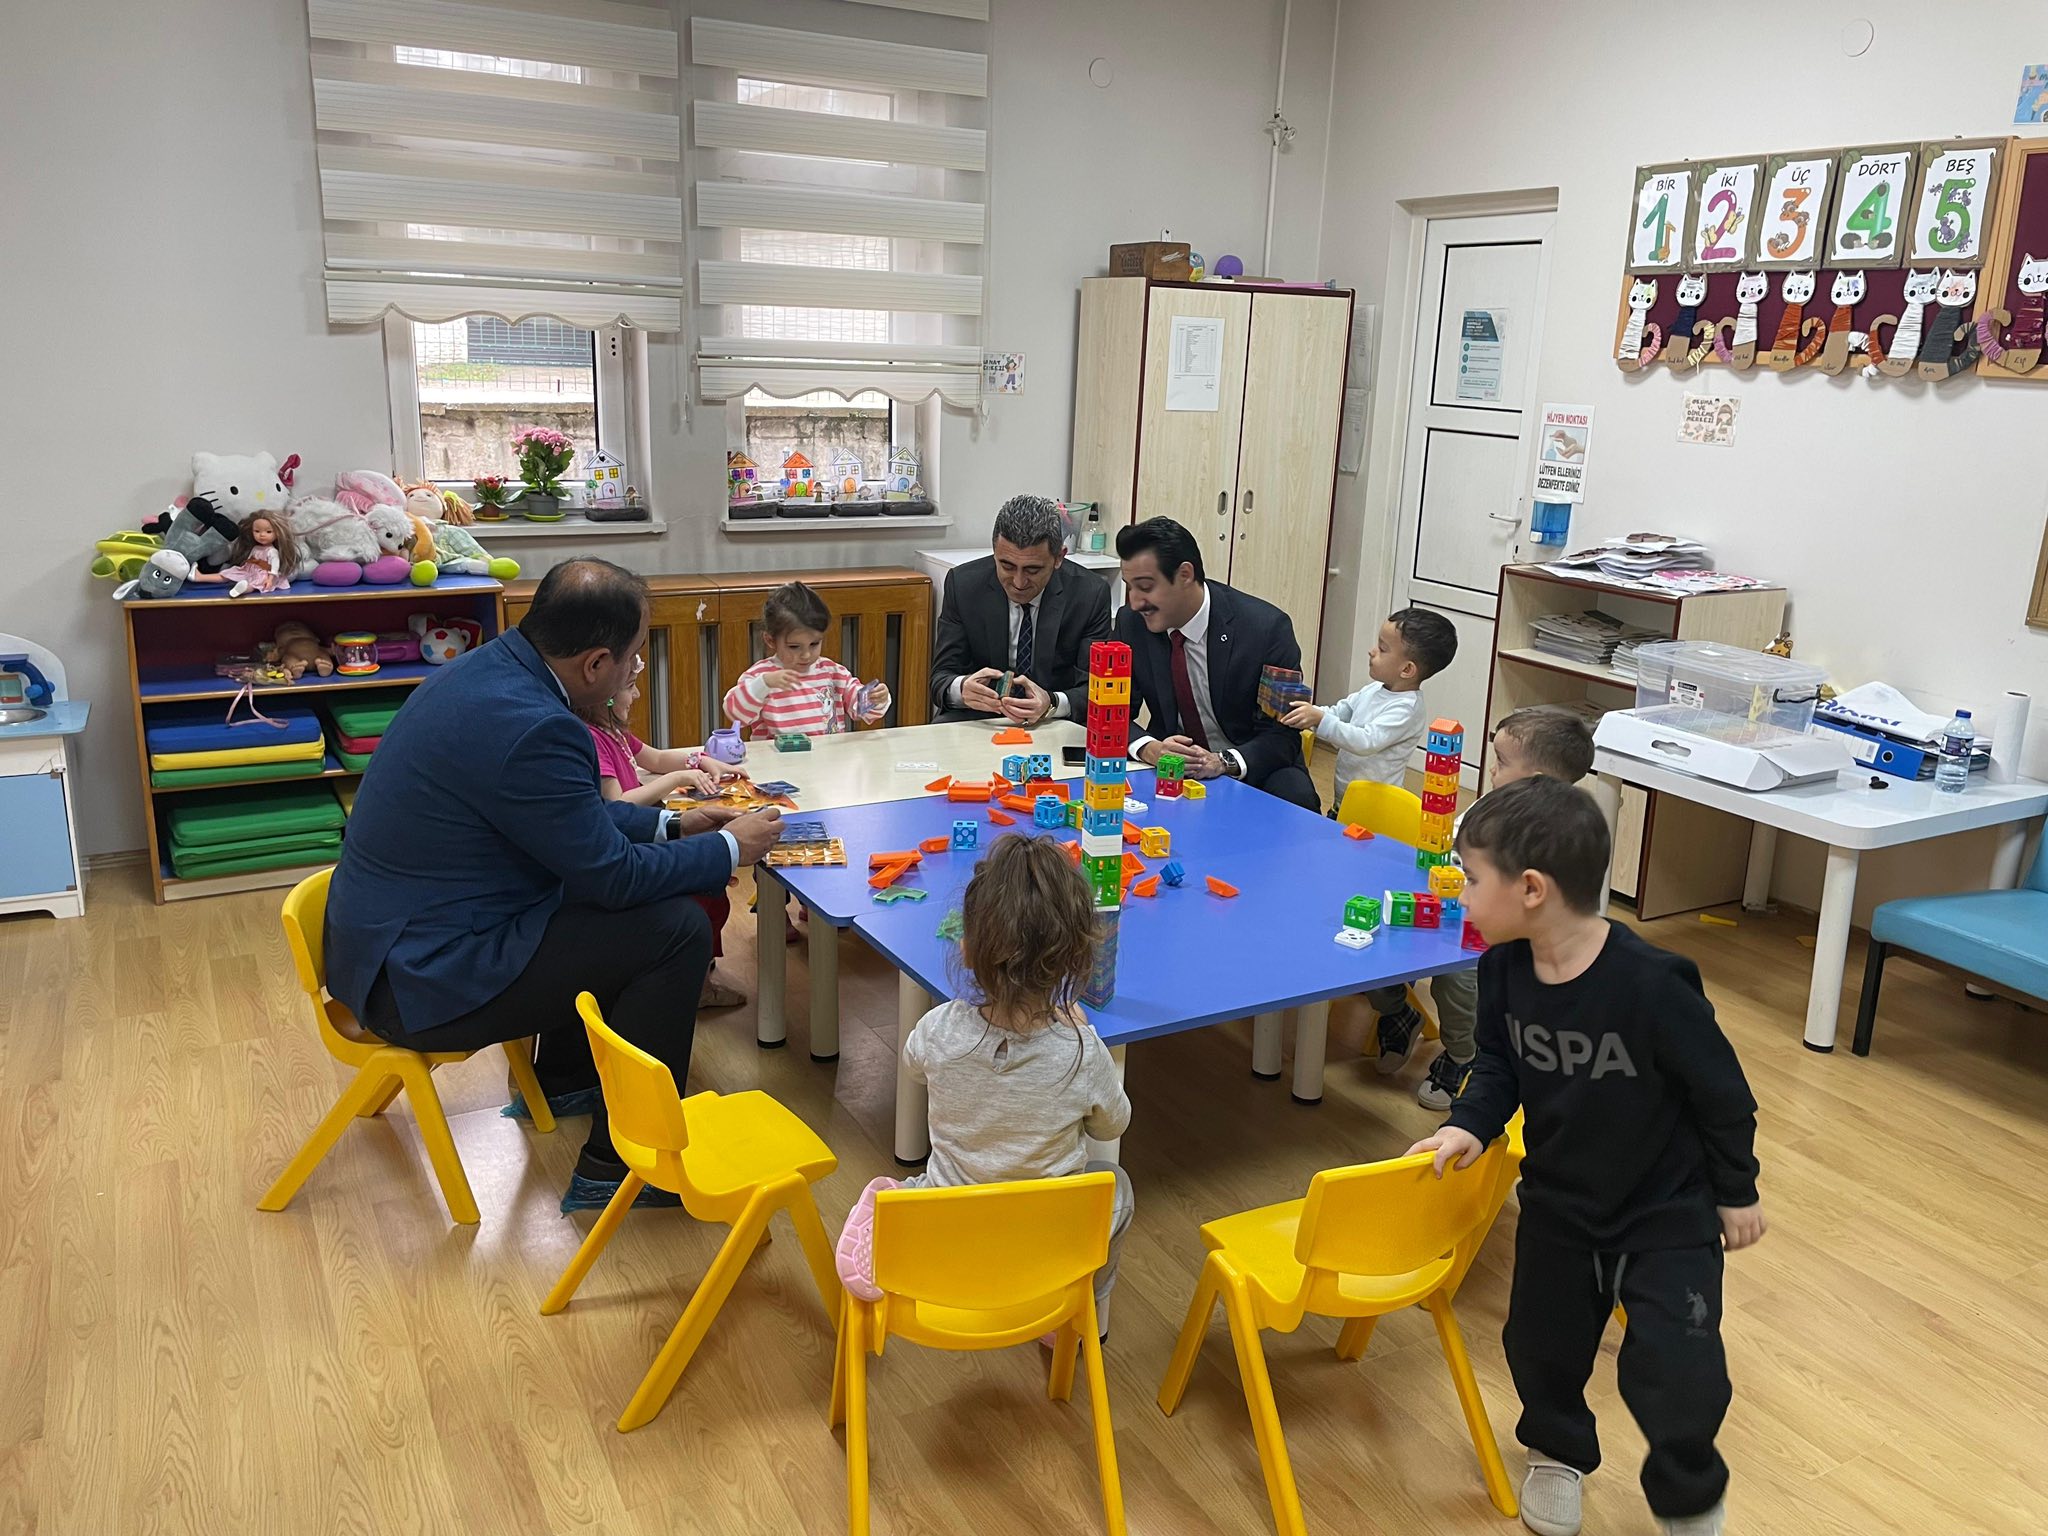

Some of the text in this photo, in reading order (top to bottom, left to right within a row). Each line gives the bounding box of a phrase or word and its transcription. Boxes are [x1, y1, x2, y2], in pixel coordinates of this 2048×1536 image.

[1858, 160, 1901, 176] DÖRT
[1945, 158, 1976, 175] BEŞ
[1656, 178, 1676, 191] BİR
[1720, 171, 1739, 187] İKİ
[1791, 167, 1811, 185] ÜÇ
[1767, 187, 1812, 259] 3
[1846, 182, 1892, 249] 4
[1928, 178, 1977, 252] 5
[1643, 193, 1669, 260] 1
[1701, 189, 1737, 260] 2
[1565, 413, 1589, 425] NOKTASI
[1539, 463, 1582, 479] LÜTFEN ELLERİNİZİ
[1537, 477, 1581, 493] DEZENFEKTE EDİNİZ
